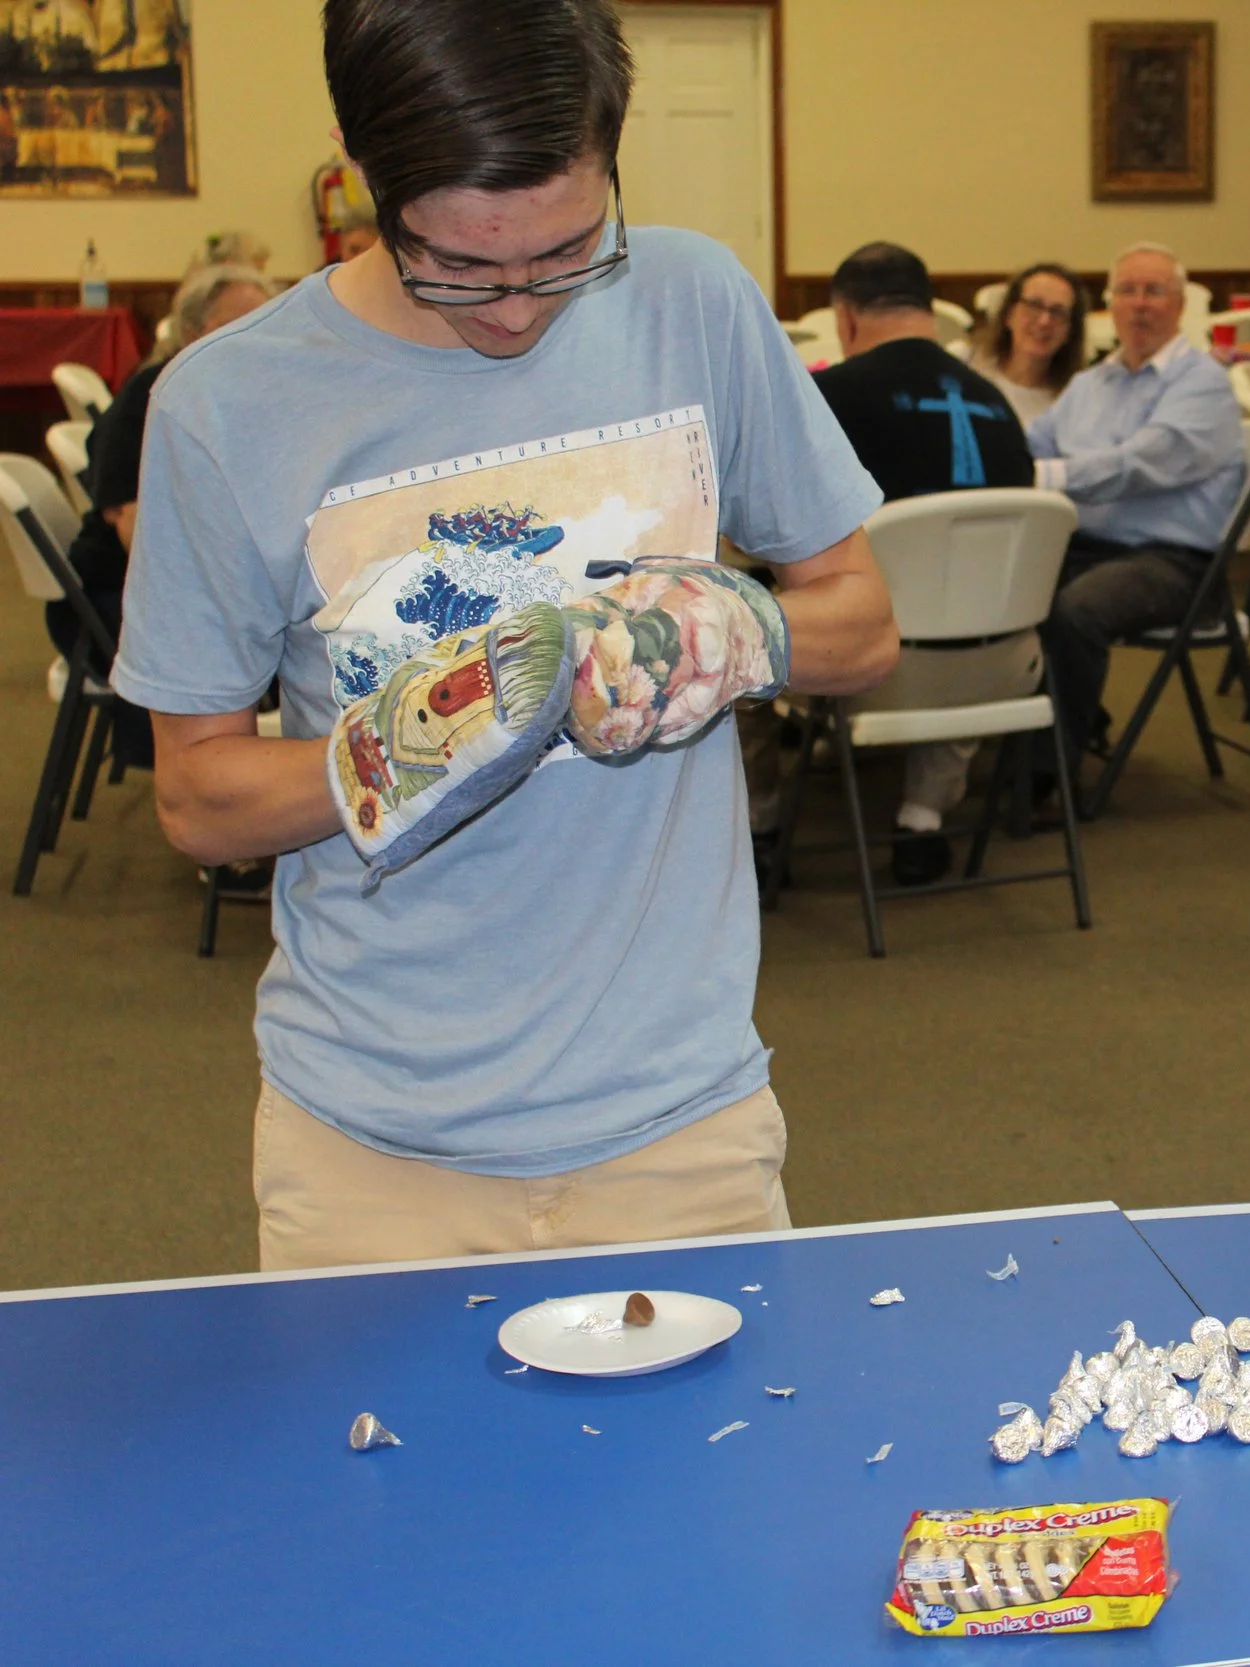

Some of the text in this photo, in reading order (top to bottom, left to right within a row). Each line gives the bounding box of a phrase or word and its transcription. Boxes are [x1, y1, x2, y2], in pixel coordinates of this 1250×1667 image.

[389, 437, 567, 486] ADVENTURE
[598, 409, 691, 440] RESORT
[693, 431, 709, 506] RIVER
[946, 1517, 1039, 1536] Duplex
[1046, 1505, 1139, 1528] Creme
[965, 1615, 1030, 1636] Duplex
[1031, 1605, 1090, 1627] Creme
